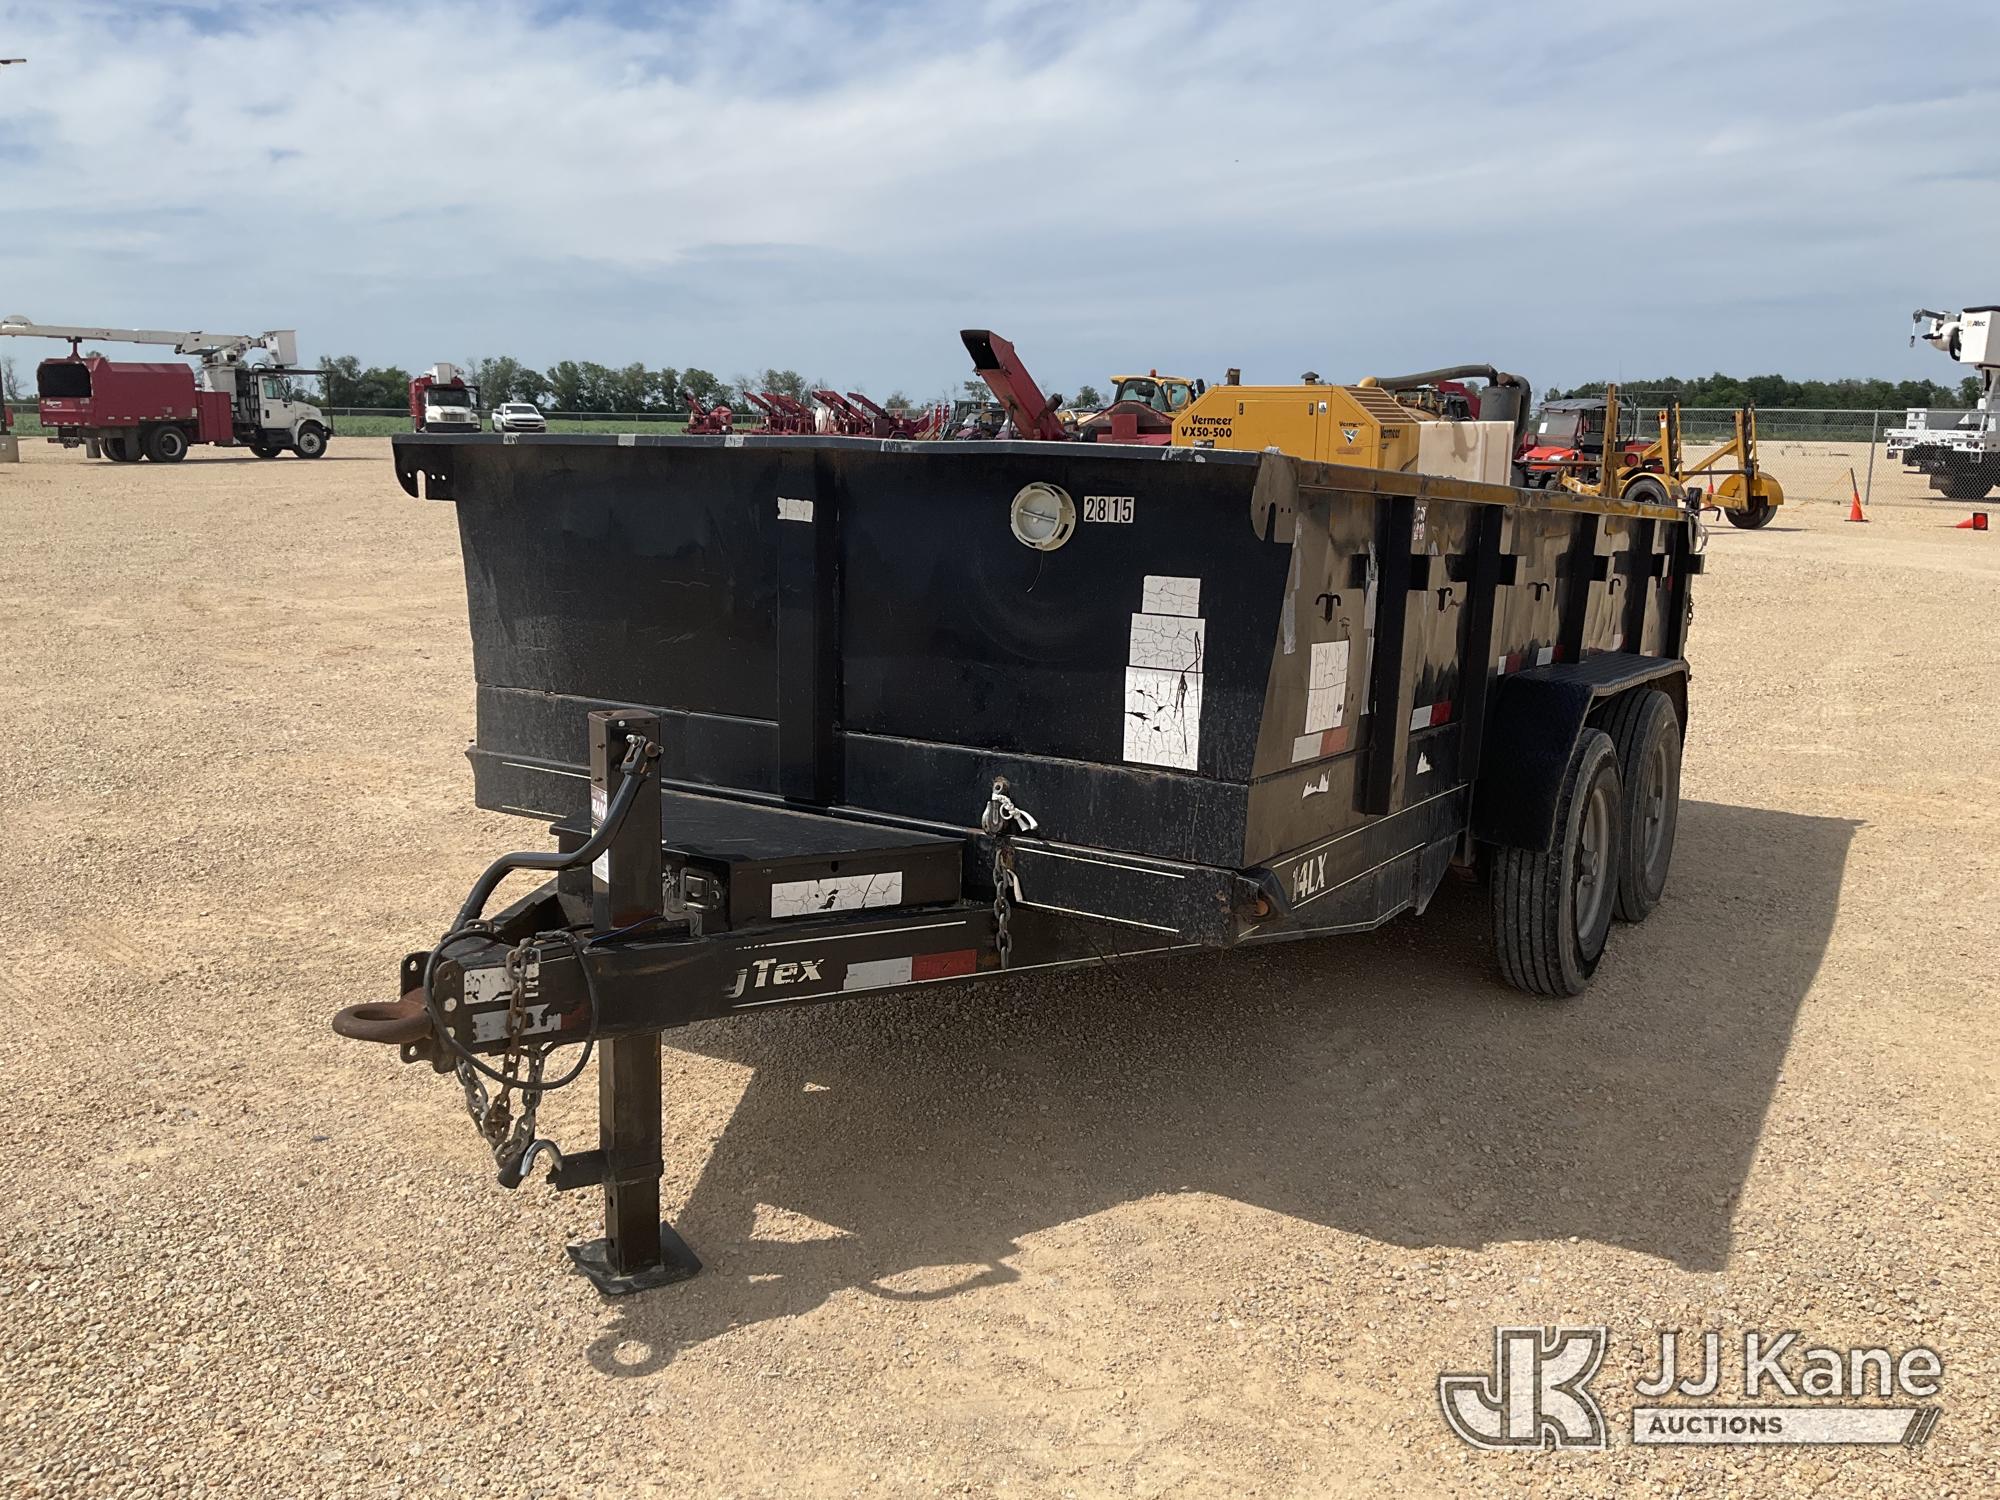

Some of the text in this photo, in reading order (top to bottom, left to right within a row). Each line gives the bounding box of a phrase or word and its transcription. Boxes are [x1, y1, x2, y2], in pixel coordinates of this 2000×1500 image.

[1192, 415, 1232, 425] Vermeer
[1181, 426, 1232, 437] VX50-500
[1085, 498, 1132, 521] 2815
